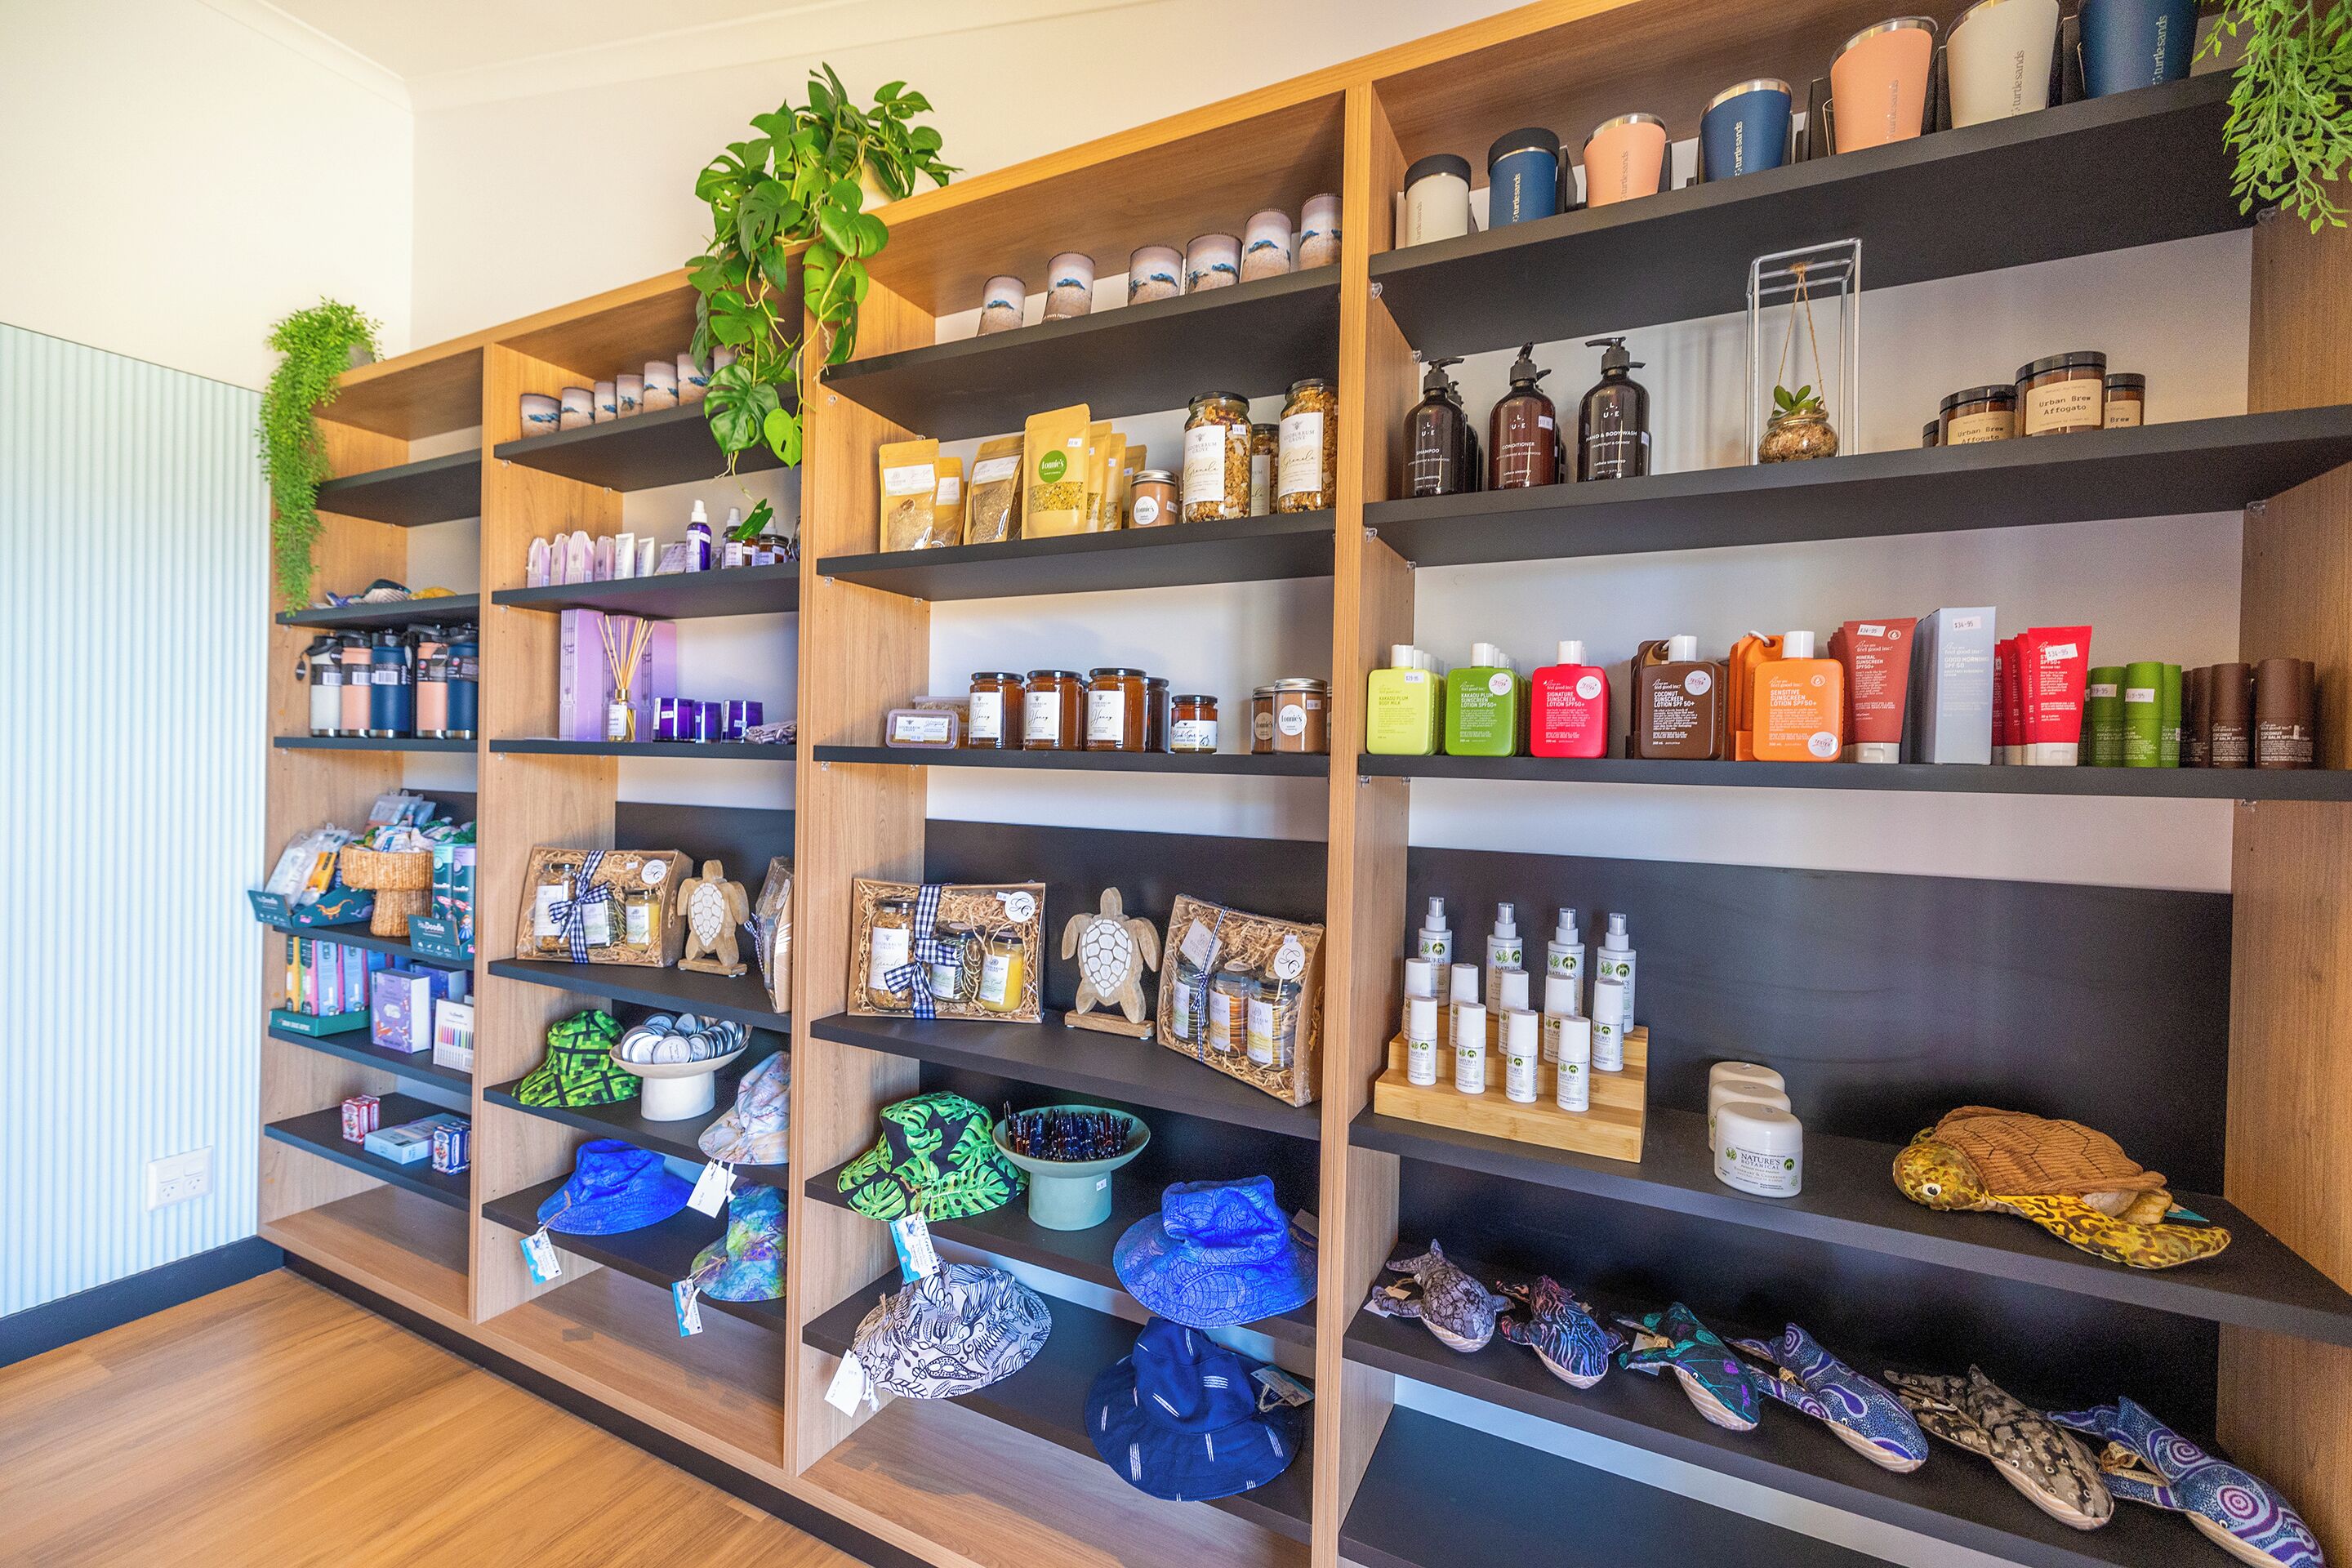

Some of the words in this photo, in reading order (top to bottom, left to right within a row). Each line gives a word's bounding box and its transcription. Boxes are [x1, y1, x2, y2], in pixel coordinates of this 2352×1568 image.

[2154, 15, 2167, 75] turtlesands
[2012, 50, 2025, 107] turtlesands
[1734, 121, 1743, 168] turtlesands
[1620, 151, 1629, 193] turtlesands
[1512, 173, 1521, 214] turtlesands
[2039, 398, 2066, 408] Urban
[2043, 404, 2087, 416] Affogato
[1586, 433, 1600, 442] HAND
[1958, 429, 1981, 437] Urban
[1502, 442, 1535, 450] CONDITIONER
[1741, 1153, 1780, 1165] NATURE'S
[1741, 1160, 1780, 1169] BOTANICAL
[924, 1237, 934, 1263] Creation
